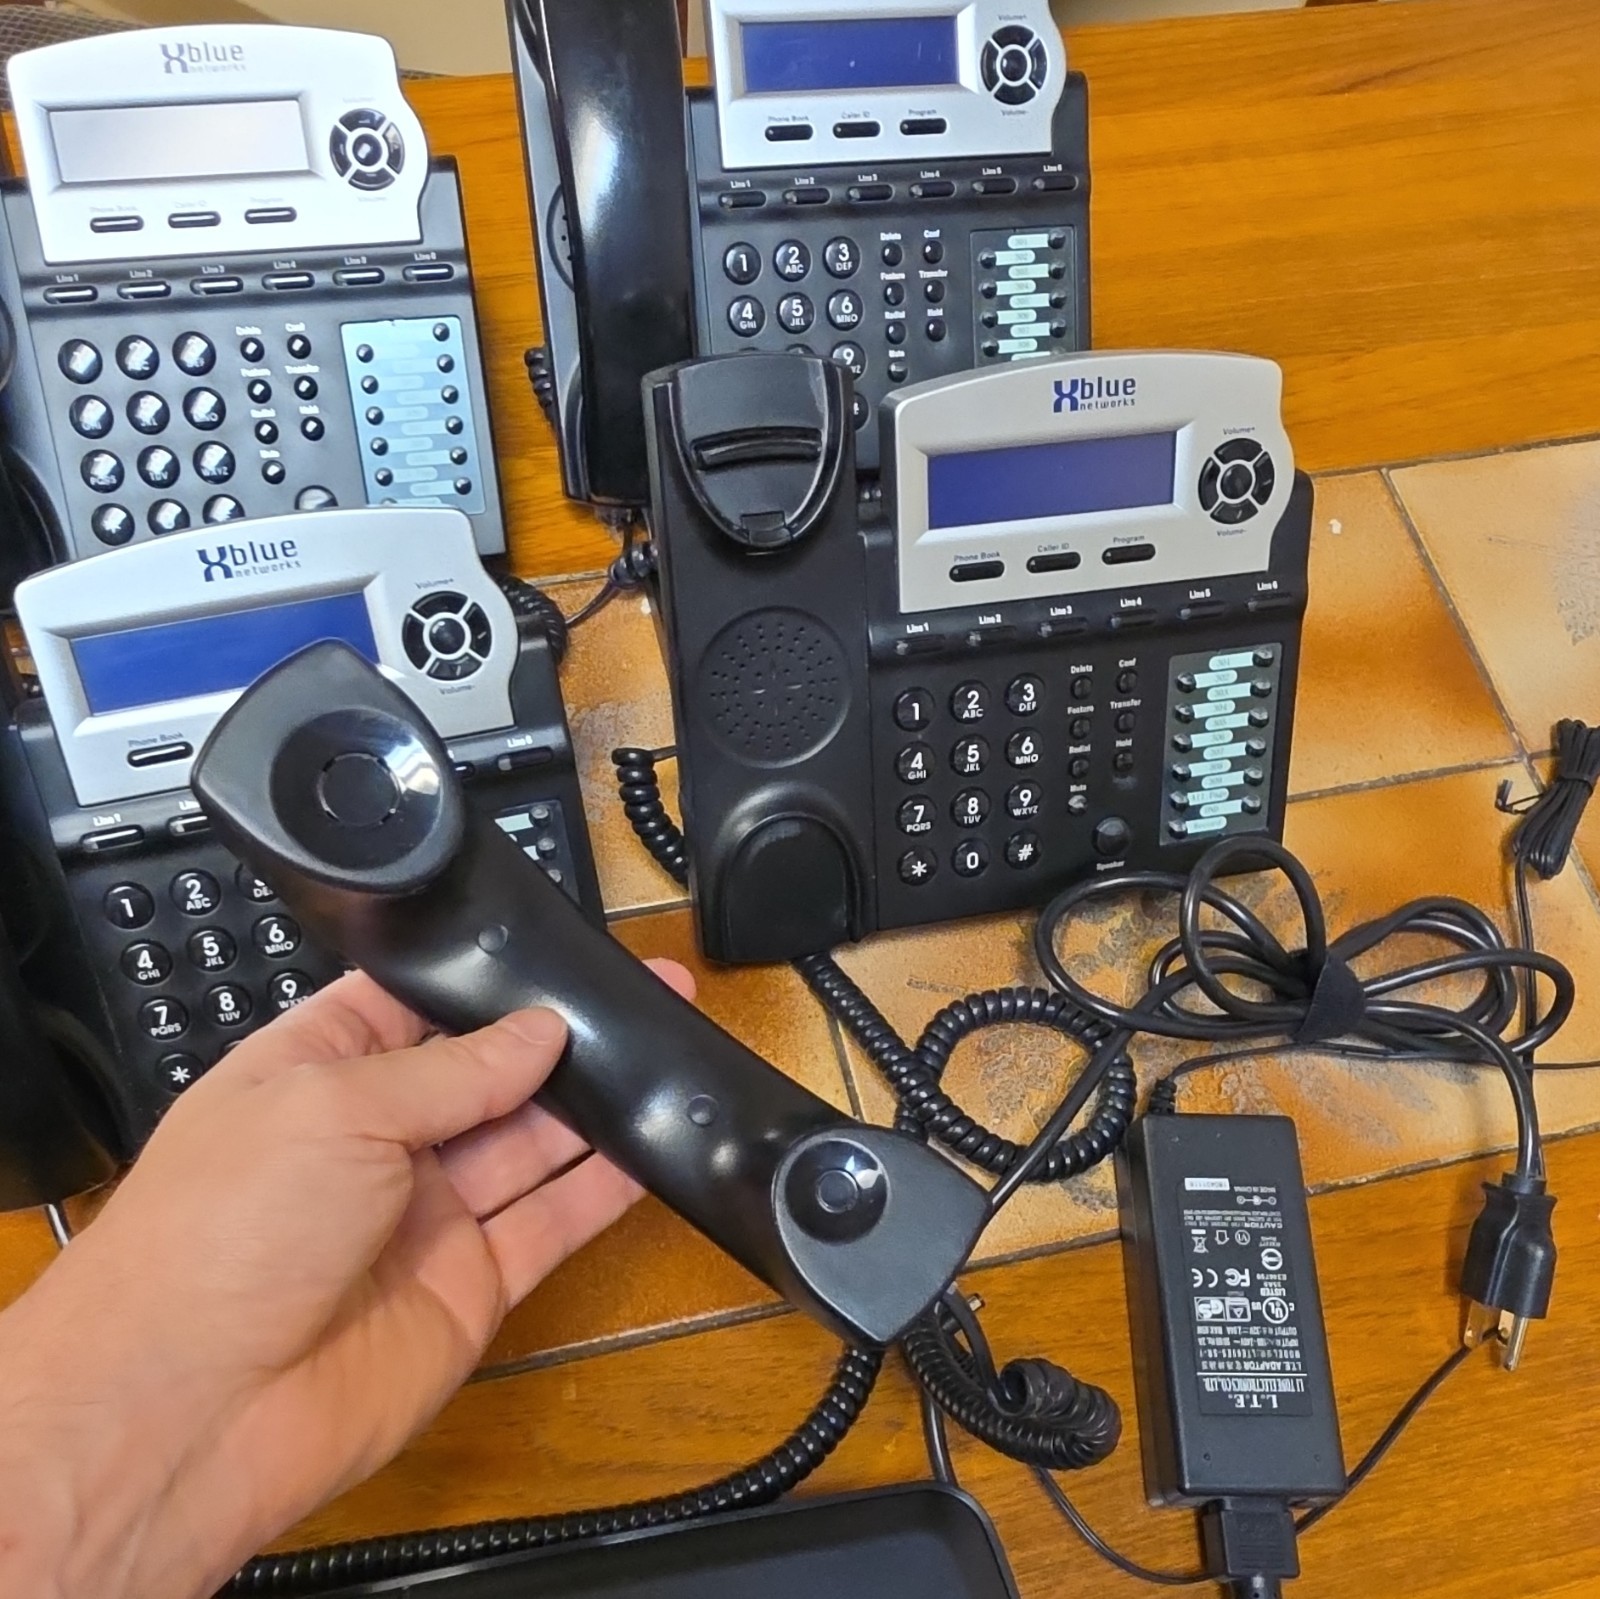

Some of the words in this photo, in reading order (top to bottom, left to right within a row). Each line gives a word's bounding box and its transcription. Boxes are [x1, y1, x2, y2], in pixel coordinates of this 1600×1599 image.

[159, 41, 245, 74] Xblue
[788, 246, 800, 264] 2
[838, 243, 850, 262] 3
[739, 253, 748, 272] 1
[784, 263, 804, 274] ABC
[836, 261, 852, 271] DEF
[742, 301, 753, 320] 4
[792, 299, 804, 317] 5
[841, 296, 854, 314] 6
[843, 347, 854, 365] 9
[1053, 376, 1136, 413] Xblue
[1080, 398, 1136, 411] networks
[1037, 543, 1060, 553] Caller
[1062, 542, 1070, 550] ID
[1112, 535, 1145, 545] Program
[196, 539, 298, 582] Xblue
[954, 553, 978, 563] Phone
[980, 551, 1000, 560] Book
[235, 559, 302, 578] networks
[1189, 590, 1205, 599] Line
[1256, 582, 1272, 591] Line
[1050, 606, 1066, 616] Line
[1120, 598, 1136, 608] Line
[906, 623, 923, 633] Line
[978, 615, 995, 625] Line
[967, 690, 980, 709] 2
[1022, 682, 1035, 702] 3
[912, 702, 920, 721] 1
[1018, 701, 1037, 712] DEF
[1110, 698, 1142, 709] Transfer
[962, 708, 984, 719] ABC
[128, 736, 158, 748] Phone
[160, 731, 184, 742] Book
[1020, 735, 1034, 755] 6
[910, 751, 924, 770] 4
[967, 744, 980, 763] 5
[1014, 754, 1039, 765] MNO
[908, 770, 927, 780] GHI
[964, 763, 981, 772] JKL
[966, 796, 979, 815] 8
[1019, 788, 1032, 807] 9
[913, 804, 924, 823] 7
[963, 814, 982, 824] TUV
[1012, 805, 1039, 816] WXYZ
[906, 821, 932, 833] PQRS
[1018, 843, 1034, 861] #
[186, 878, 204, 900] 2
[252, 886, 274, 898] DE
[120, 898, 135, 918] 1
[186, 896, 212, 911] ABC
[268, 922, 286, 943] 6
[202, 935, 220, 957] 5
[136, 949, 154, 969] 4
[204, 955, 225, 967] JKL
[138, 968, 160, 980] GHI
[281, 979, 298, 998] 9
[218, 991, 236, 1012] 8
[154, 1005, 169, 1027] 7
[218, 1010, 241, 1023] TUV
[150, 1022, 182, 1037] PQRS
[1228, 1393, 1278, 1408] L.T.E.
